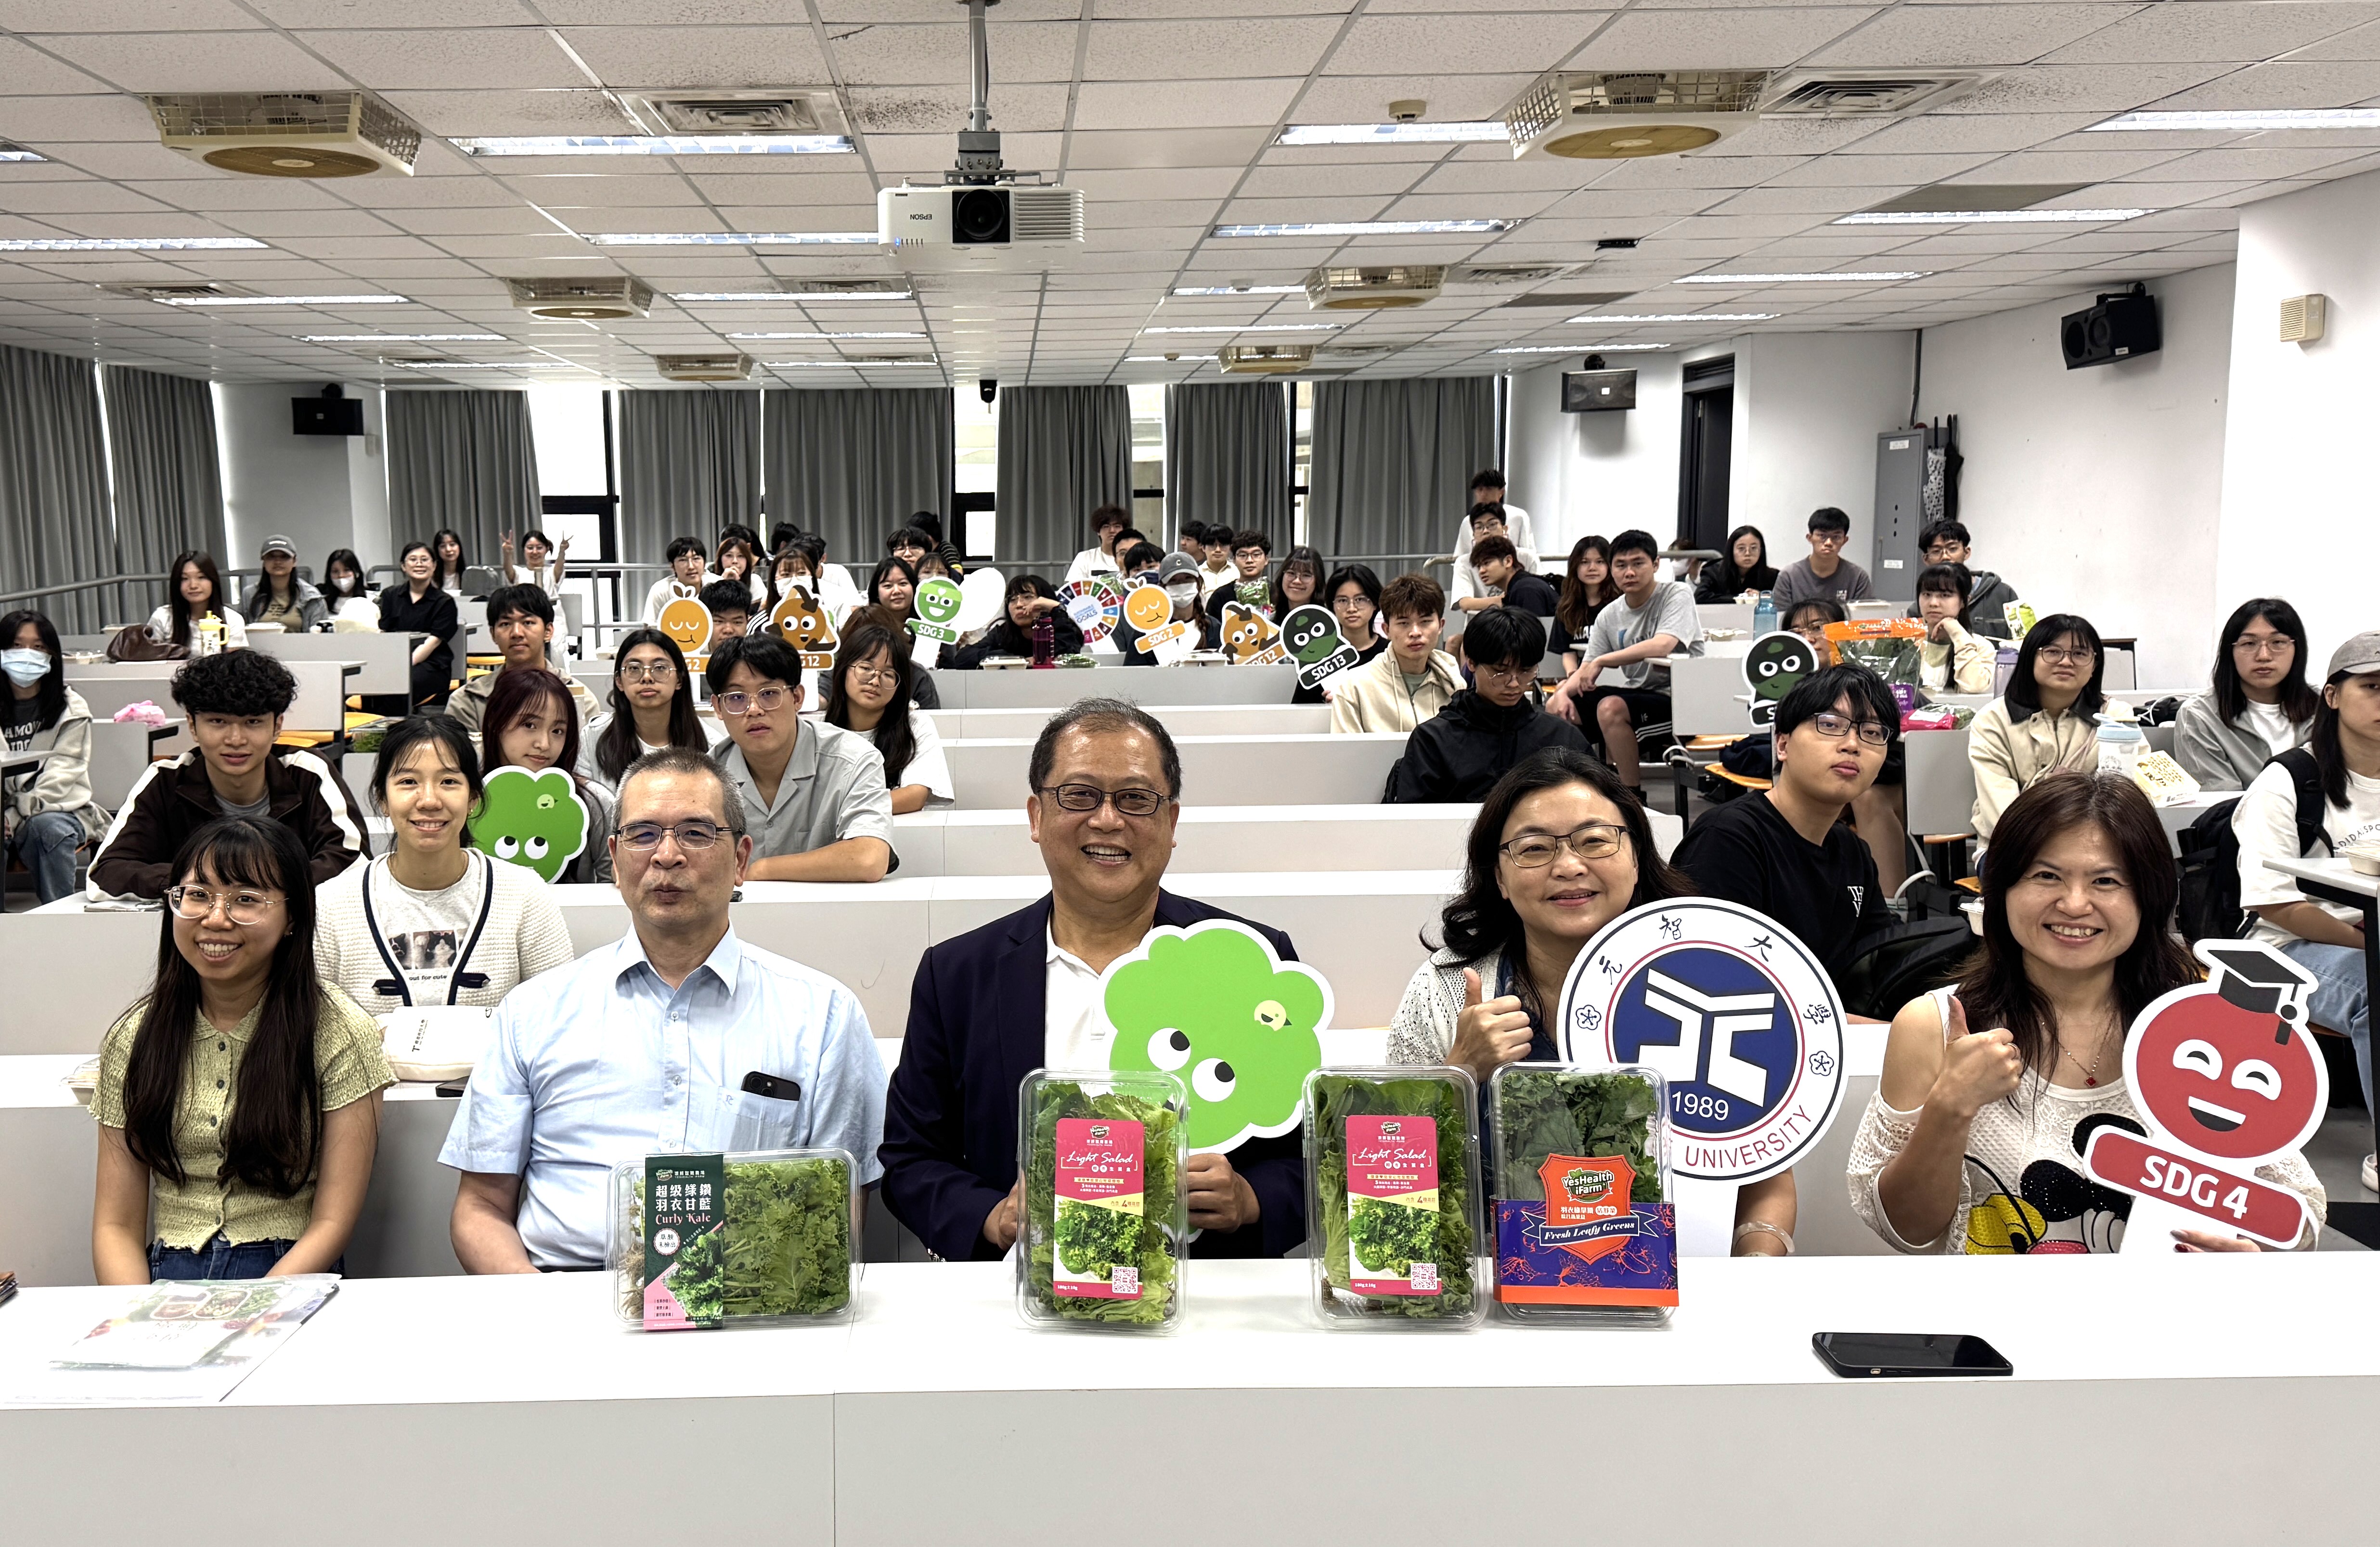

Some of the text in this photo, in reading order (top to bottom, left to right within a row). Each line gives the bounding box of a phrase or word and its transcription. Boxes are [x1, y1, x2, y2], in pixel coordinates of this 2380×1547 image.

[1077, 610, 1098, 623] GOALS
[917, 624, 944, 638] SDG 3
[1148, 628, 1175, 646] SDG 2
[807, 656, 820, 667] 12
[1265, 650, 1278, 662] 12
[693, 659, 700, 670] 2
[1311, 655, 1346, 680] SDG 13
[1671, 1091, 1730, 1121] 1989
[1685, 1105, 1811, 1169] UNIVERSITY
[1067, 1151, 1133, 1166] Light Salad
[1358, 1148, 1426, 1162] Light Salad
[1563, 1171, 1613, 1187] YesHealth
[1576, 1184, 1602, 1195] iFarm
[2139, 1155, 2250, 1220] SDG 4
[656, 1198, 711, 1211] 羽衣甘藍
[656, 1212, 711, 1225] Curly Kale
[1544, 1222, 1635, 1240] Fresh Leafy Greens
